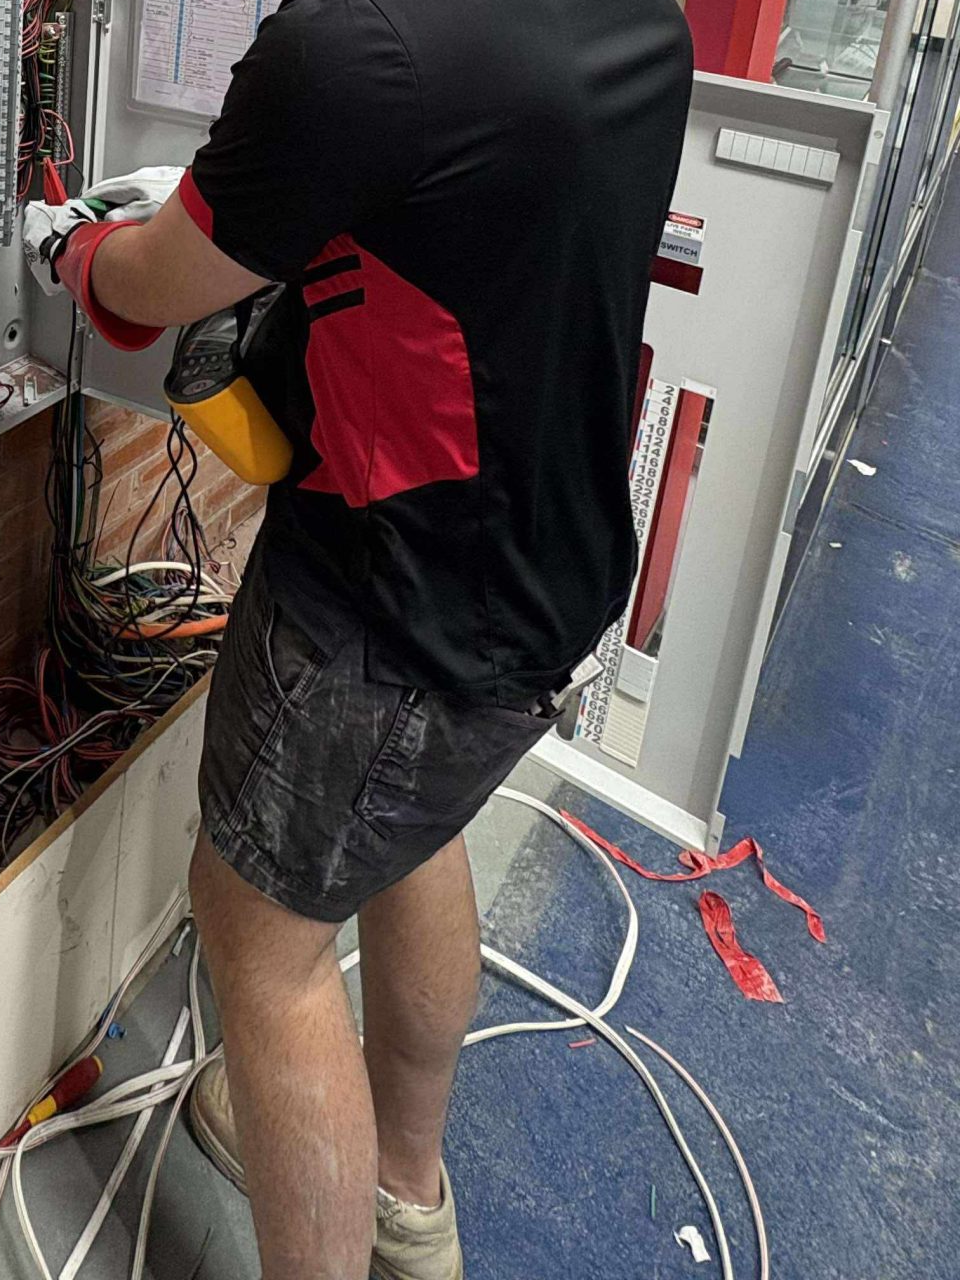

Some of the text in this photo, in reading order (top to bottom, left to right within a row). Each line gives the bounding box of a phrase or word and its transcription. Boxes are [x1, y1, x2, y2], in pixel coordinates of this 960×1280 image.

[660, 241, 698, 257] SWITCH
[664, 385, 675, 396] 2
[662, 397, 672, 406] 4
[660, 406, 669, 416] 6
[658, 417, 667, 426] 8
[647, 424, 665, 437] 10
[645, 434, 663, 447] 12
[643, 444, 660, 457] 14
[641, 454, 658, 467] 16
[639, 465, 656, 477] 18
[635, 474, 654, 488] 20
[633, 484, 652, 499] 22
[631, 494, 649, 508] 24
[635, 529, 643, 538] 0
[603, 633, 621, 648] 52
[602, 642, 619, 656] 54
[600, 652, 616, 666] 56
[606, 666, 615, 676] 8
[593, 681, 611, 696] 62
[591, 691, 608, 705] 64
[589, 700, 606, 715] 66
[587, 710, 604, 724] 68
[585, 718, 602, 734] 70
[583, 728, 600, 744] 72
